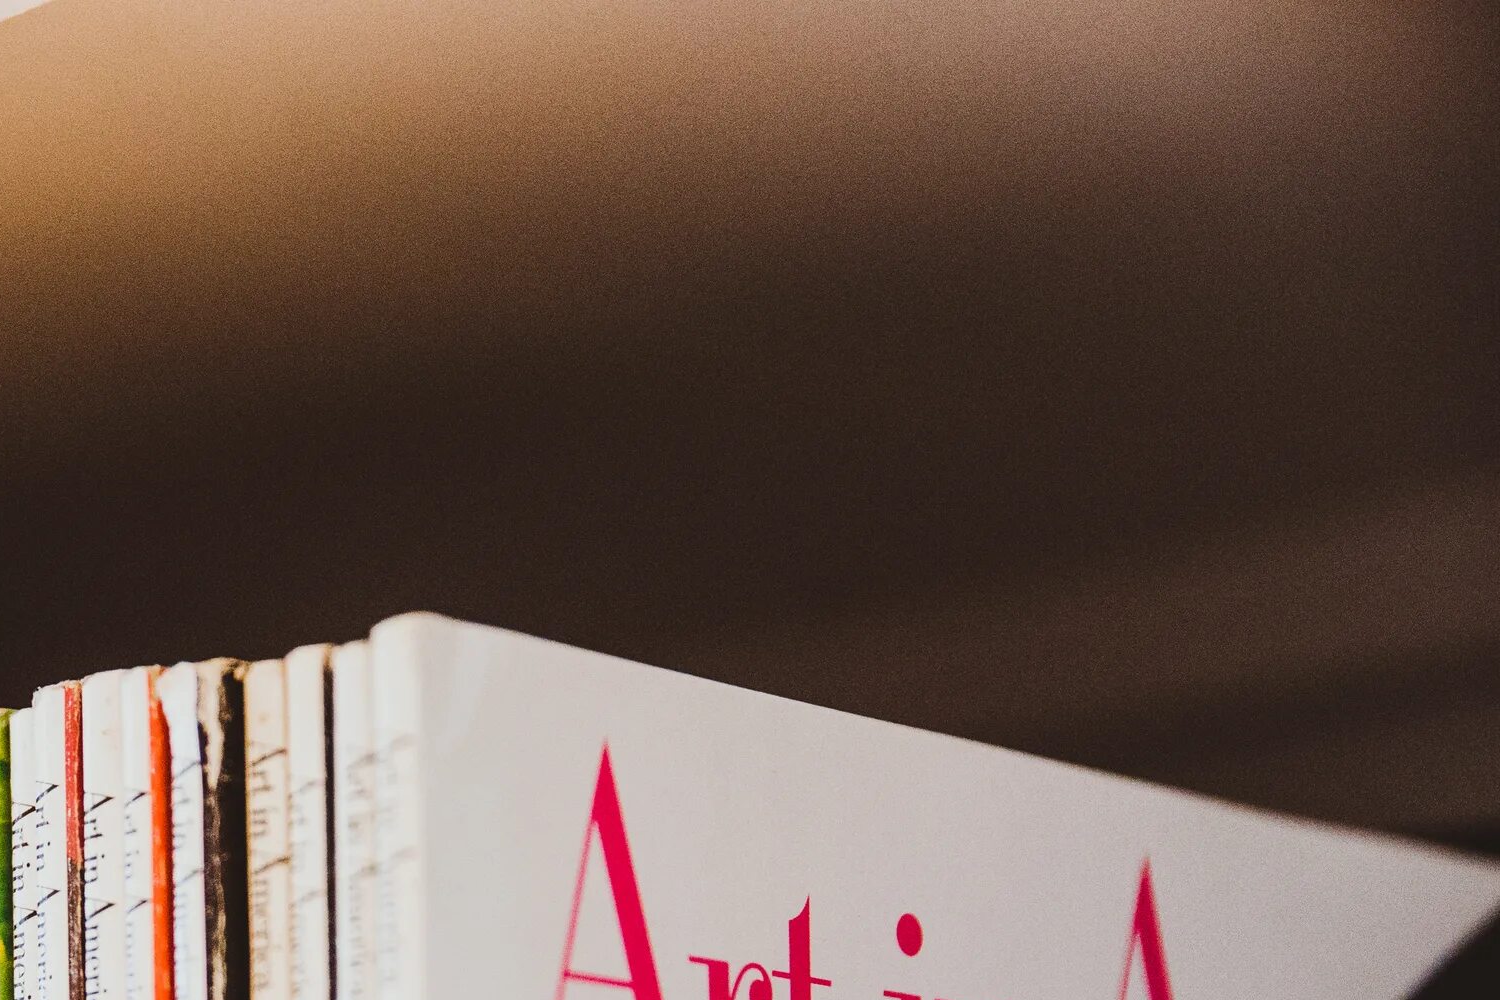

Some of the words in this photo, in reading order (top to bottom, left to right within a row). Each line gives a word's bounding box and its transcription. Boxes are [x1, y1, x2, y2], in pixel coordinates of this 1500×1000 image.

[36, 780, 60, 828] Art
[84, 790, 117, 843] Art
[12, 800, 37, 855] Art
[37, 841, 51, 872] in
[84, 853, 106, 886] in
[13, 862, 31, 894] in
